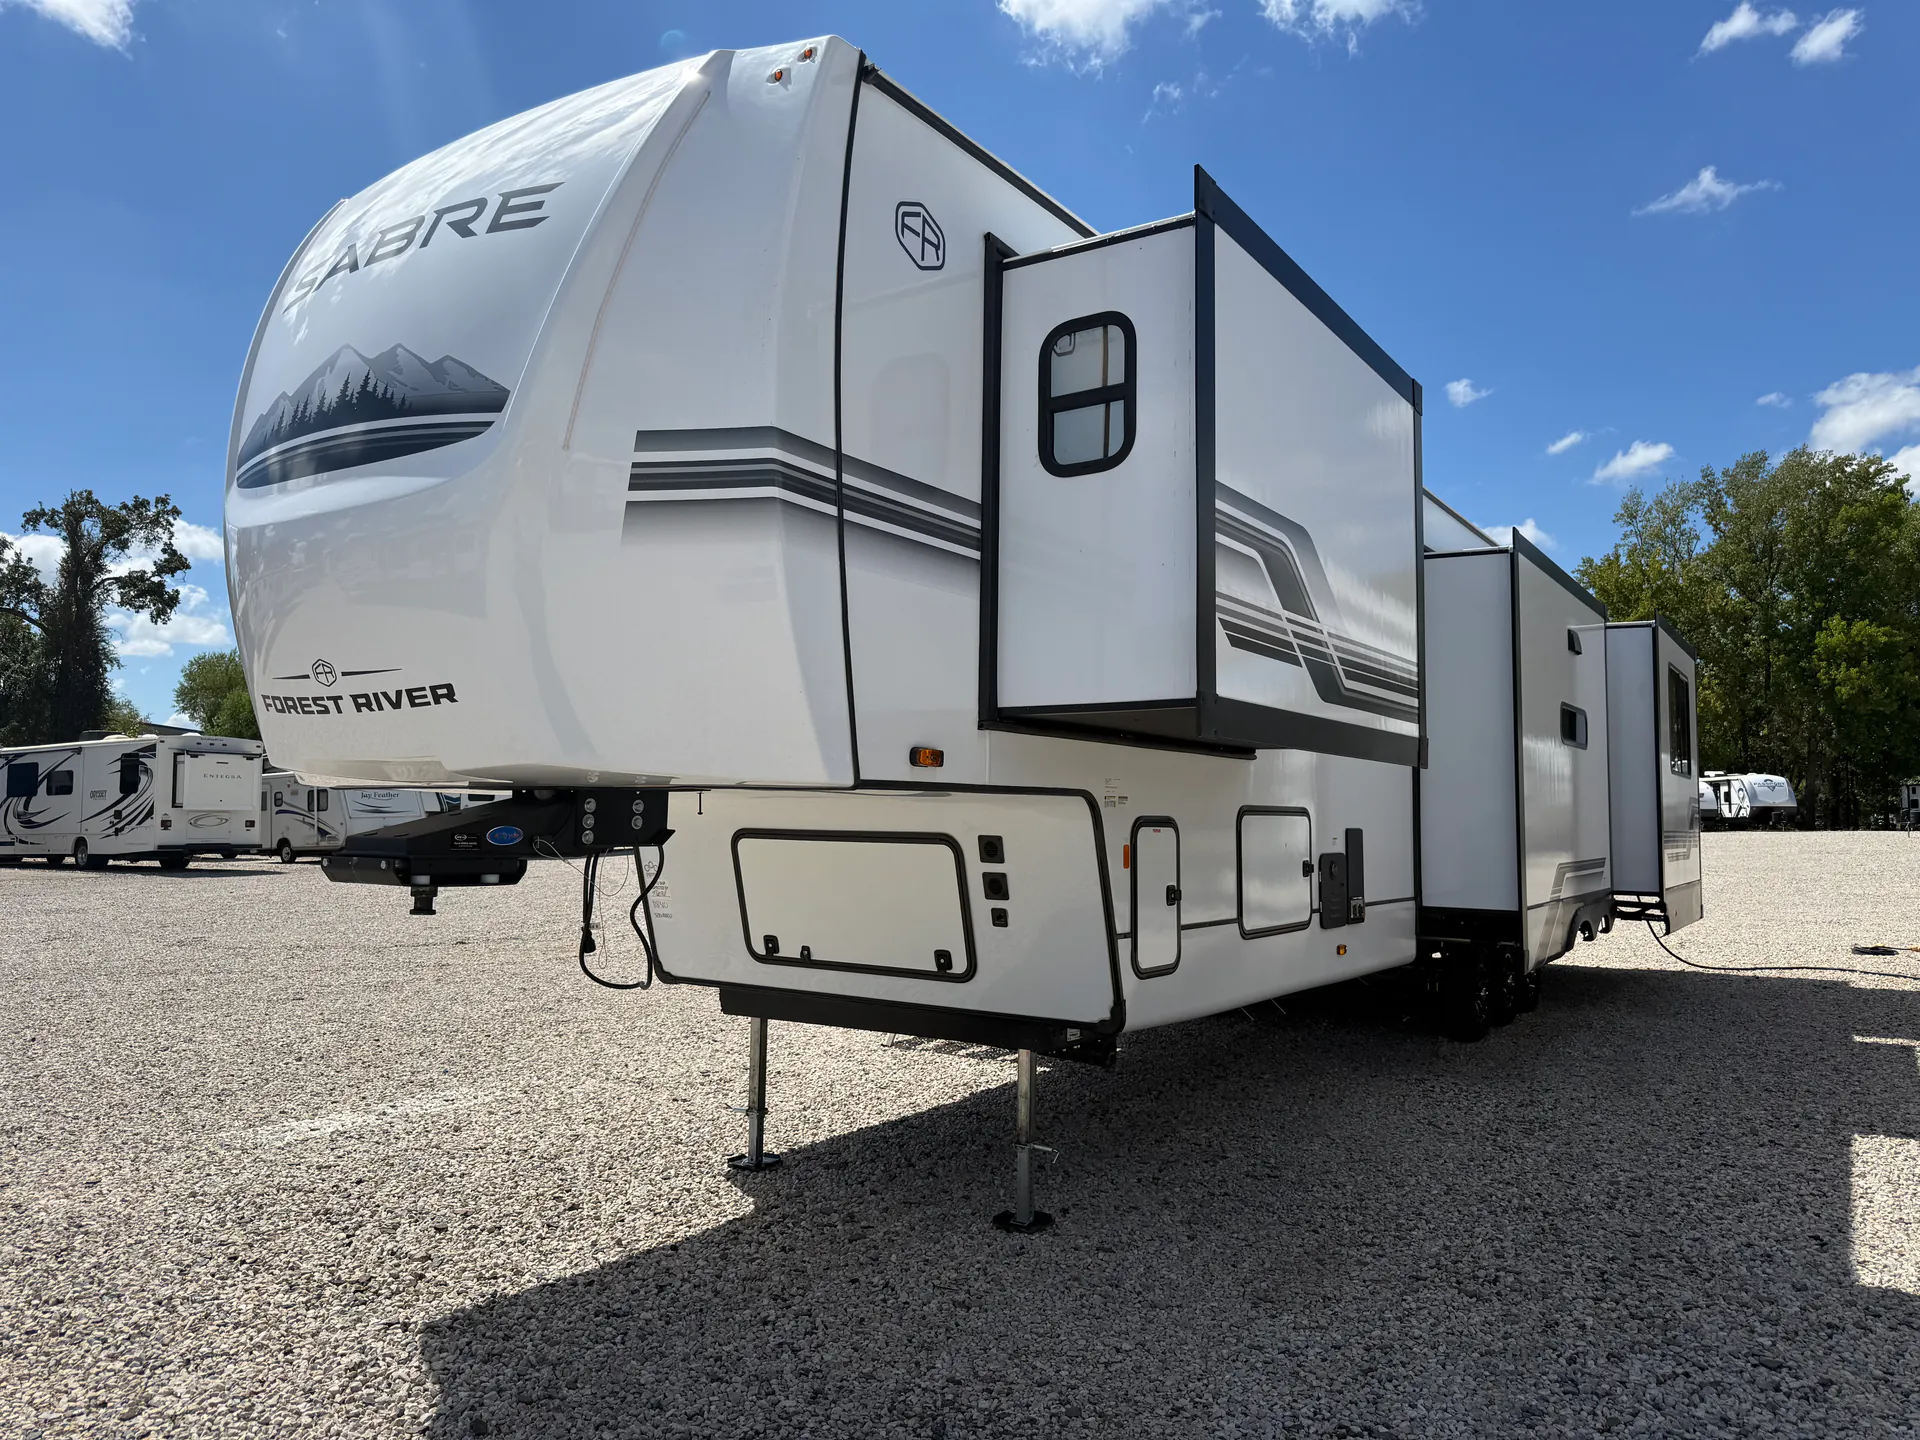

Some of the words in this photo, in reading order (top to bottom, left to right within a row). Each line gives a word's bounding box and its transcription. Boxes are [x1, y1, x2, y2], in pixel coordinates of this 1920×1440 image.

[282, 181, 566, 315] SABRE
[261, 694, 343, 715] FOREST
[349, 683, 459, 713] RIVER
